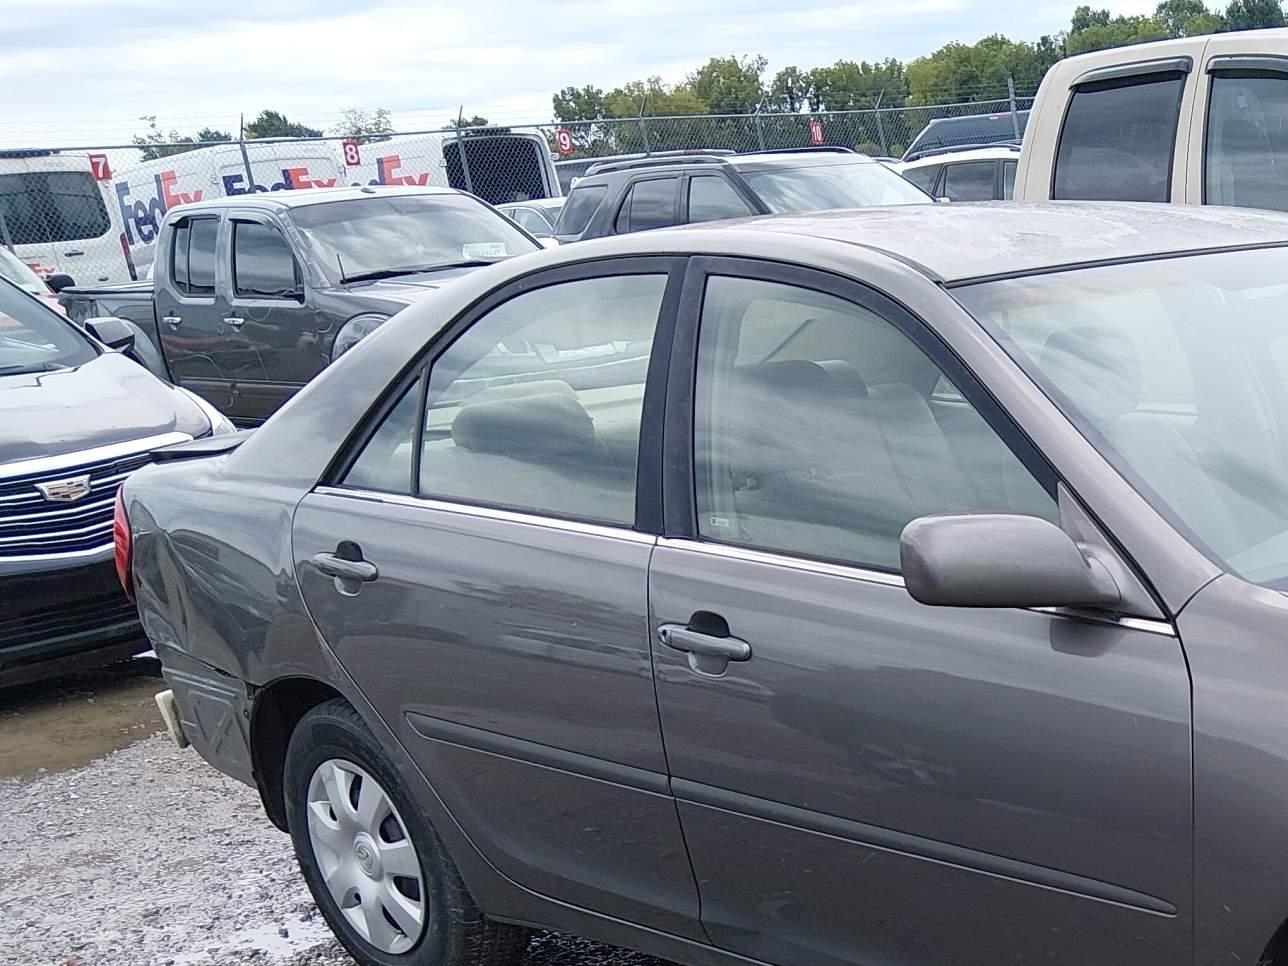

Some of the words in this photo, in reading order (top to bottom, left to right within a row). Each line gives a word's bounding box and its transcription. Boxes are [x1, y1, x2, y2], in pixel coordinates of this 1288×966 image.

[559, 132, 570, 151] 9
[812, 123, 822, 142] 10
[345, 143, 359, 164] 8
[91, 157, 106, 178] 7
